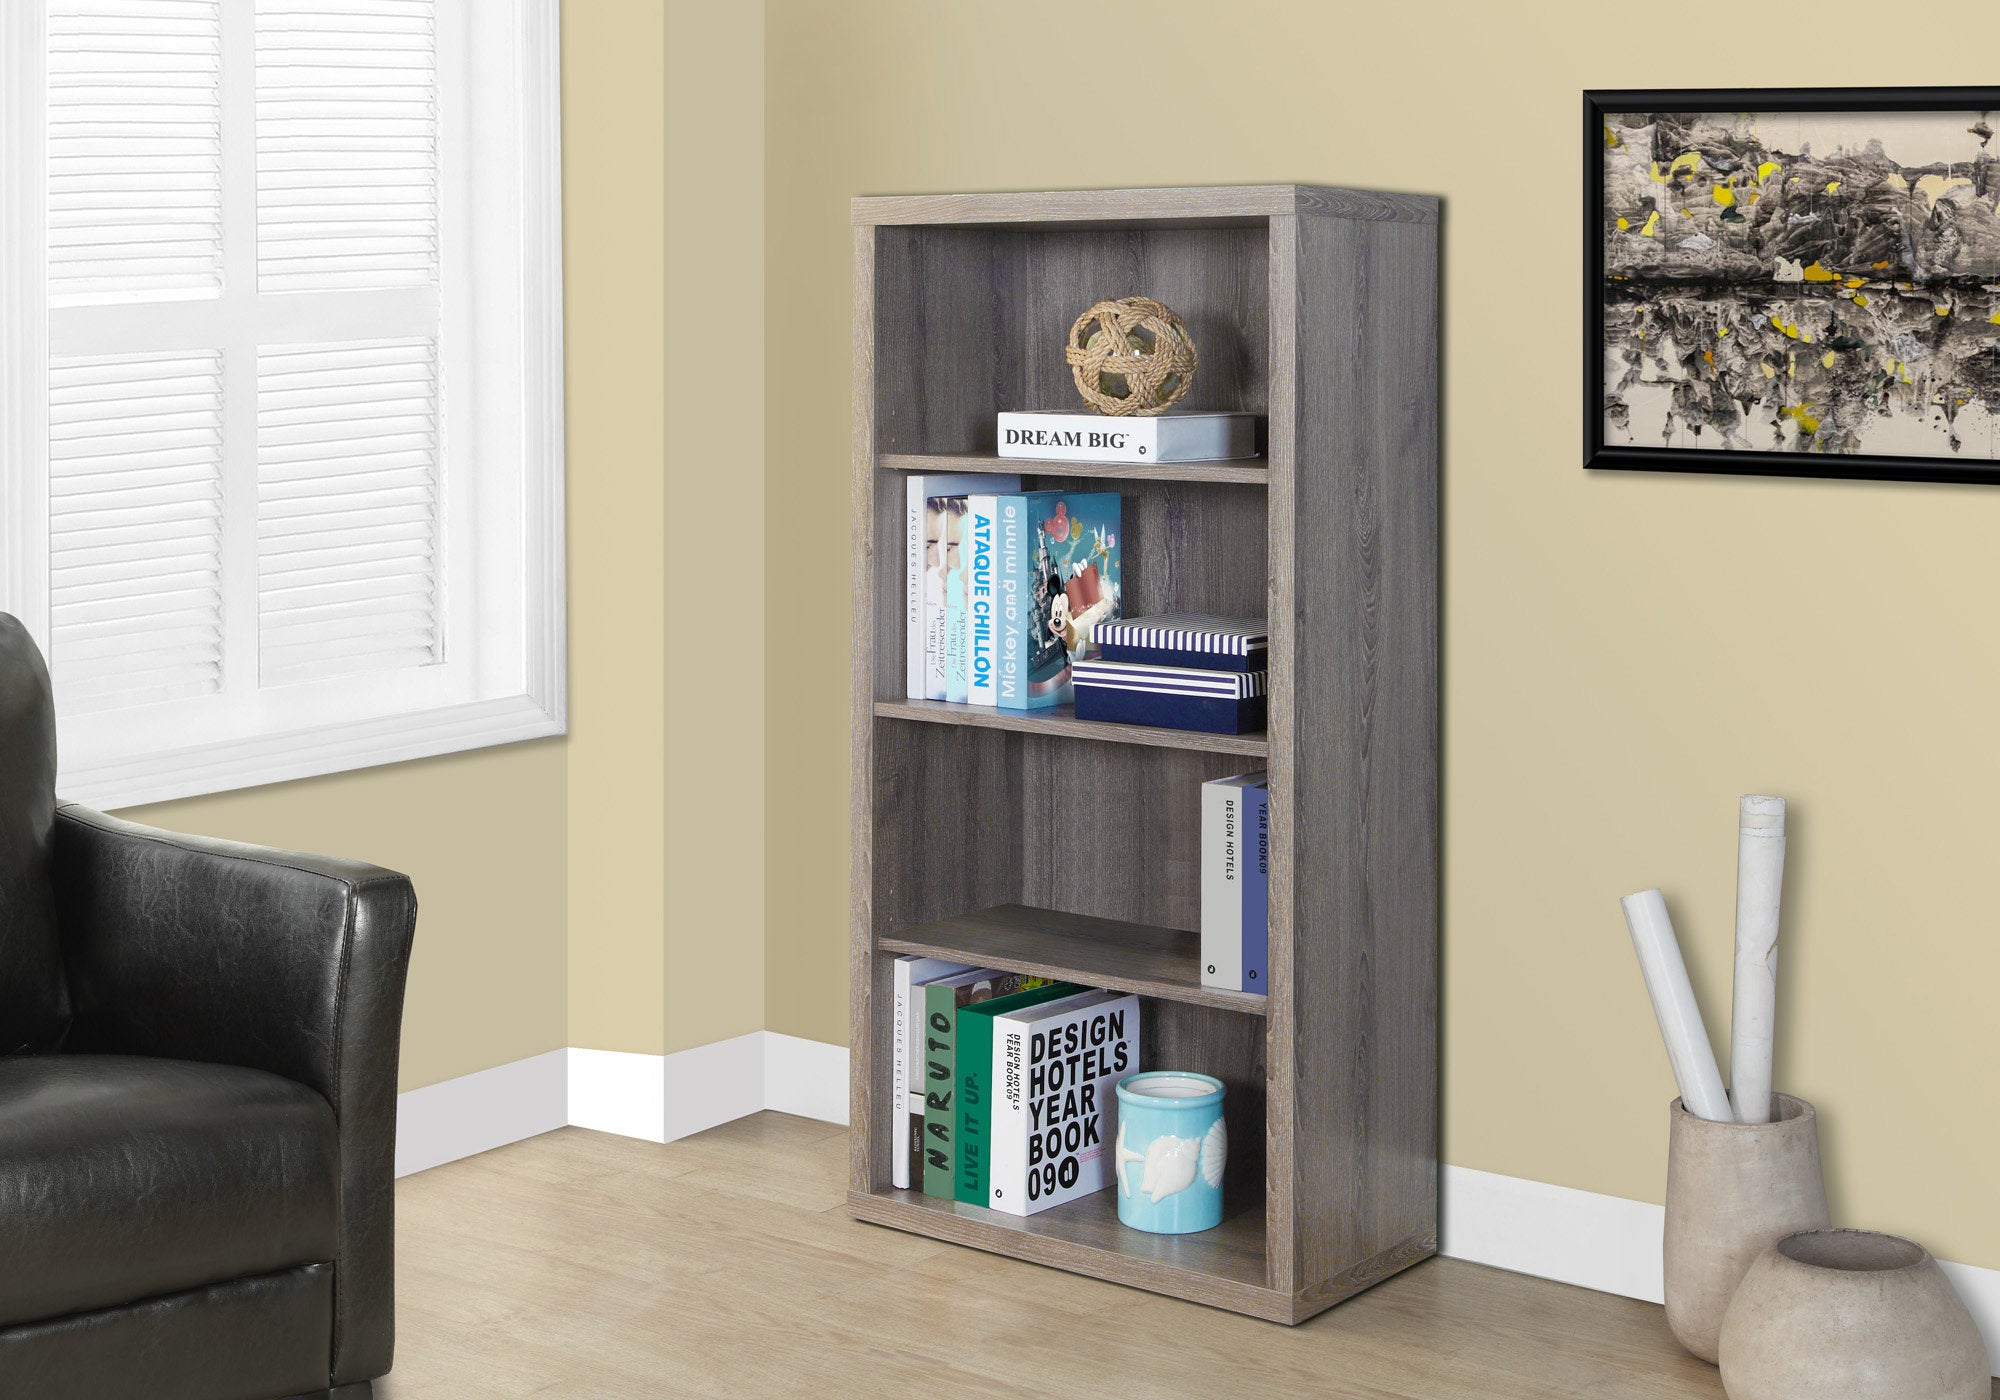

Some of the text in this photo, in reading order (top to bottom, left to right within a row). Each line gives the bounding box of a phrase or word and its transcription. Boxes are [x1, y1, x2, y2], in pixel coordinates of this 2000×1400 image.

[1005, 429, 1082, 447] DREAM
[973, 513, 991, 597] ATAQUE
[1001, 505, 1020, 698] Mickey and minnie
[926, 630, 937, 654] Frau
[947, 633, 957, 657] Frau
[1226, 799, 1235, 881] DESIGN HOTELS
[1258, 803, 1268, 829] YEAR
[1006, 1032, 1015, 1058] YEAR
[1030, 1010, 1125, 1065] DESIGN
[925, 1012, 952, 1172] NARUTO
[1012, 1033, 1022, 1111] DESIGN HOTELS
[1030, 1041, 1128, 1099] HOTELS
[964, 1112, 980, 1135] IT
[1029, 1083, 1096, 1131] YEAR
[1029, 1114, 1100, 1166] BOOK
[963, 1142, 979, 1192] LIVE
